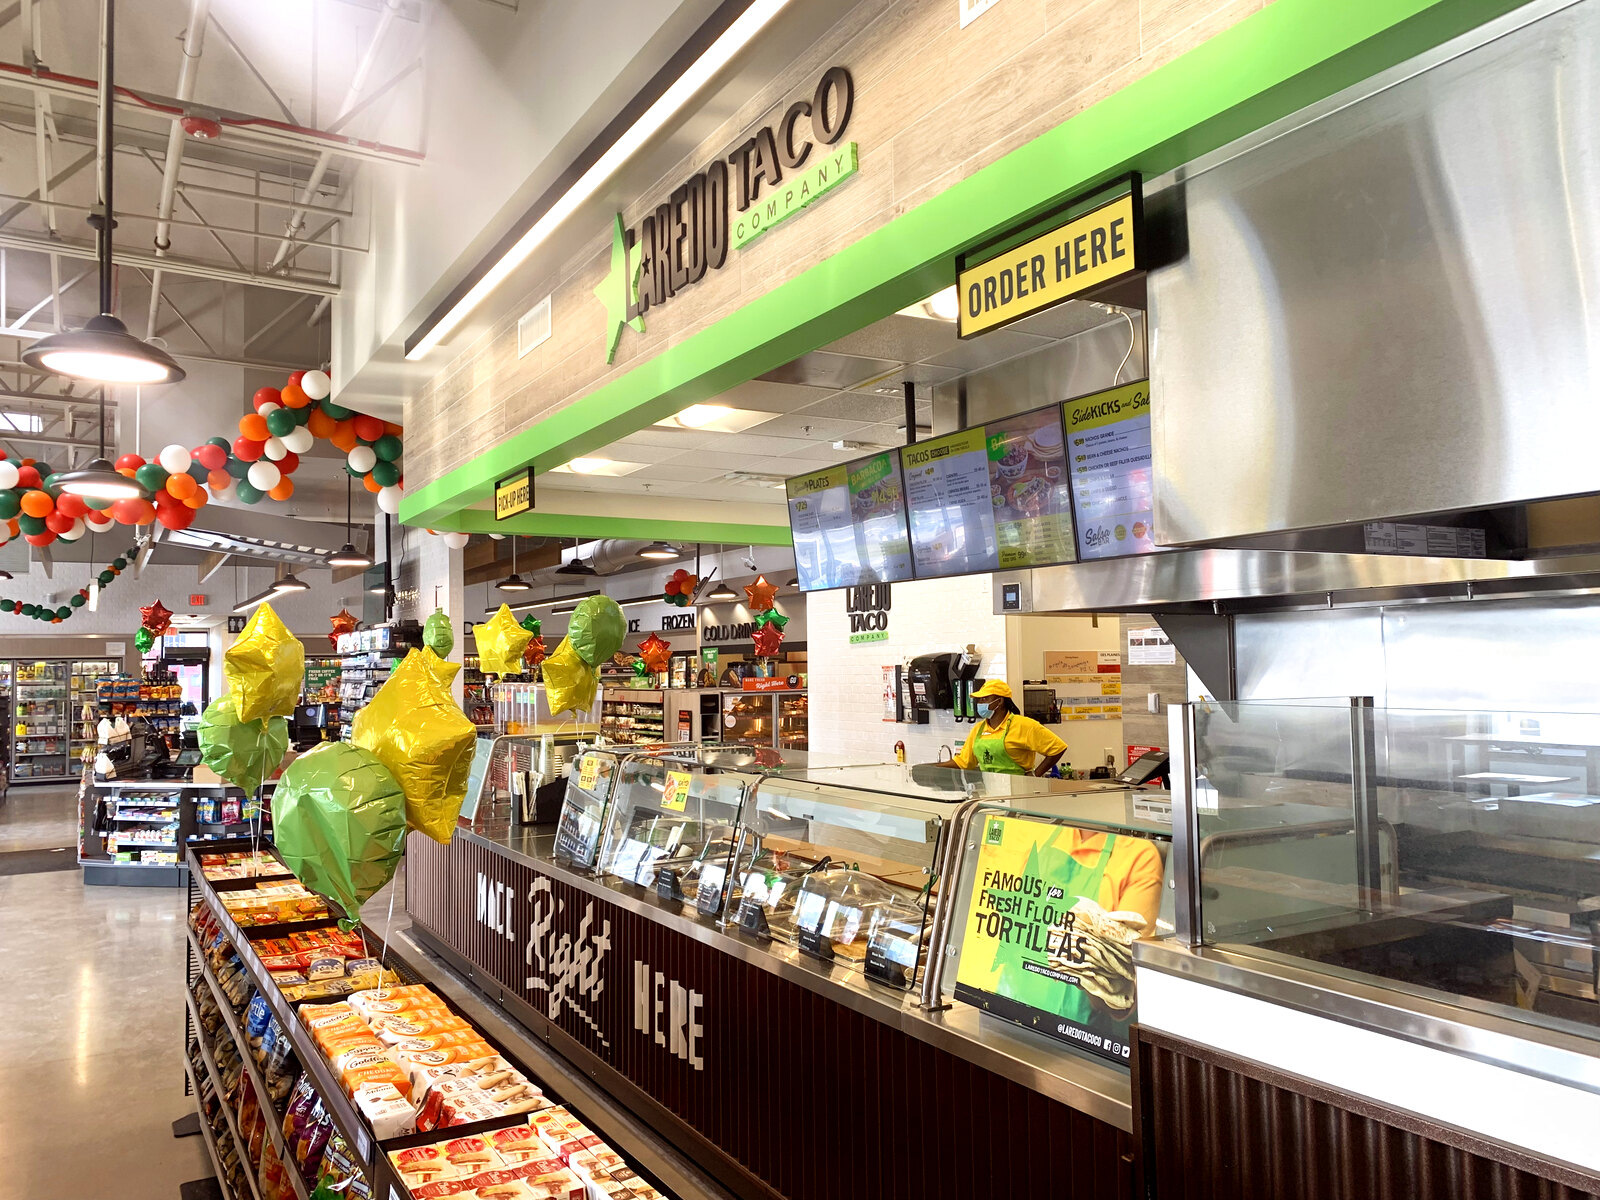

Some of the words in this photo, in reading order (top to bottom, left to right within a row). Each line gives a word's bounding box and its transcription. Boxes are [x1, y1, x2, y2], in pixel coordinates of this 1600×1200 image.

[625, 160, 728, 322] LAREDO
[729, 66, 854, 211] TACO
[736, 154, 843, 240] COMPANY
[968, 254, 1046, 318] ORDER
[1055, 217, 1126, 283] HERE
[1133, 392, 1150, 409] Sal
[907, 450, 929, 466] TACOS
[809, 476, 829, 490] PLATES
[846, 583, 891, 613] LAREDO
[628, 618, 641, 633] ICE
[662, 613, 695, 631] FROZEN
[704, 625, 729, 642] COLD
[848, 611, 888, 633] TACO
[983, 870, 1044, 898] FAMOUS
[1047, 884, 1063, 901] for
[979, 889, 1022, 916] FRESH
[1025, 900, 1075, 932] FLOUR
[975, 912, 1087, 964] TORTILLAS
[526, 876, 612, 1020] Right
[634, 960, 704, 1071] HERE
[1057, 1024, 1102, 1047] @LAREDOTACOCO
[349, 1055, 389, 1069] Goldfish
